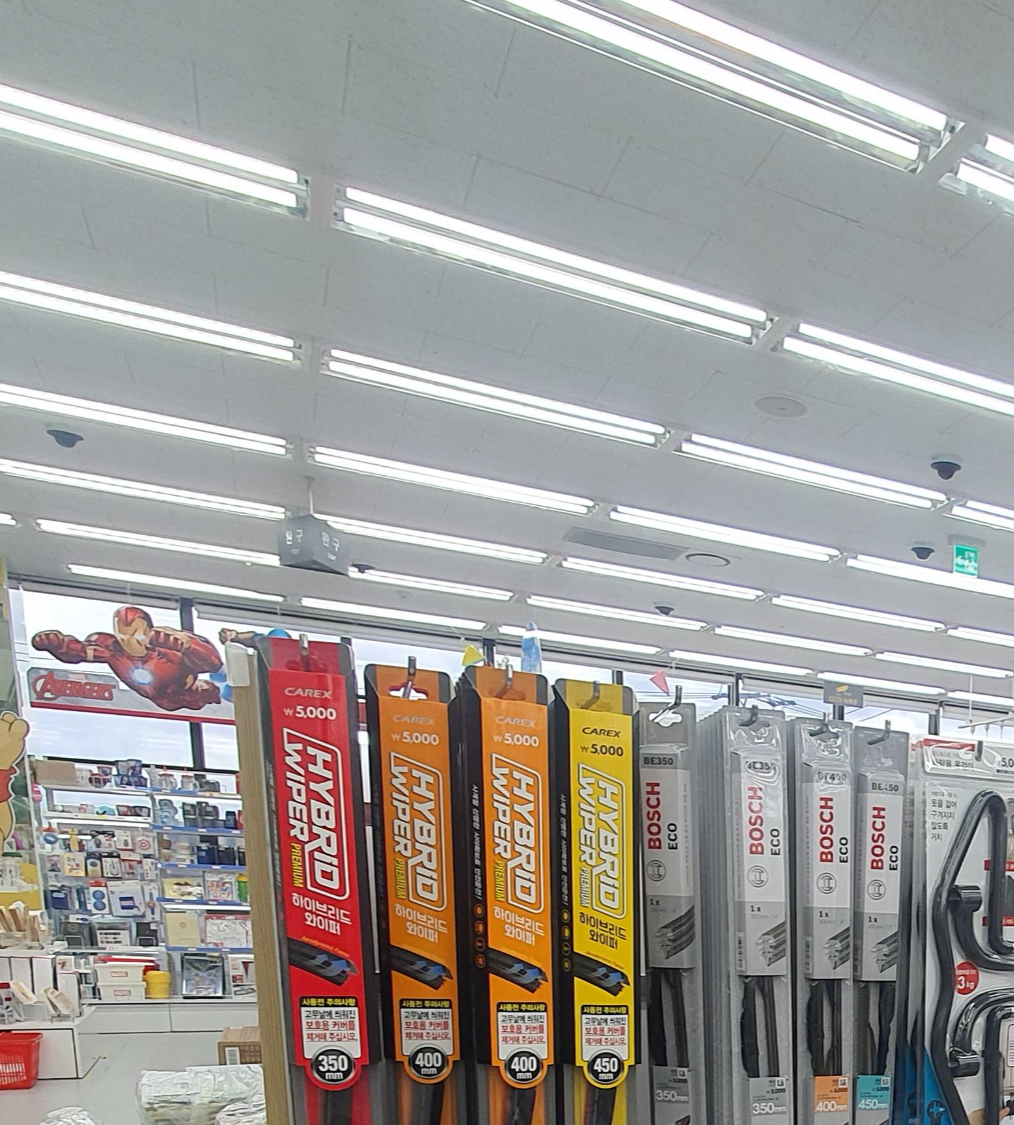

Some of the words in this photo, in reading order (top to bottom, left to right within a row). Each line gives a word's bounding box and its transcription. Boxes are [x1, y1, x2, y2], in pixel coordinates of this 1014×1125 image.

[284, 687, 332, 699] CAREX
[494, 715, 537, 728] CAREX
[582, 726, 621, 738] CAREX
[643, 757, 674, 766] BE350
[284, 743, 309, 842] WIPER
[871, 782, 899, 792] BE450
[306, 746, 341, 890] HYBRID
[391, 765, 413, 858] WIPER
[492, 767, 512, 860] WIPER
[579, 777, 596, 867] WIPER
[646, 782, 662, 849] BOSCH
[747, 786, 765, 855] BOSCH
[411, 768, 438, 901] HYBRID
[512, 770, 537, 909] HYBRID
[667, 822, 678, 850] ECO
[770, 828, 781, 856] ECO
[819, 796, 834, 863] BOSCH
[870, 806, 886, 870] BOSCH
[598, 780, 620, 909] HYBRID
[838, 836, 849, 863] ECO
[889, 845, 899, 871] ECO
[291, 843, 304, 888] PREMIUM
[580, 866, 590, 908] PREMIUM
[292, 893, 352, 924] 하이브리드
[395, 903, 448, 933] 하이브리드
[493, 906, 545, 936] 하이브리드
[304, 912, 341, 935] 와이퍼
[405, 921, 438, 943] 와이퍼
[504, 923, 536, 945] 와이퍼
[579, 912, 627, 940] 하이브리드
[589, 929, 618, 950] 와이퍼
[319, 1055, 349, 1071] 350
[415, 1053, 442, 1067] 400
[511, 1056, 537, 1072] 400
[593, 1058, 619, 1073] 450
[752, 1102, 786, 1114] 350mm
[816, 1101, 848, 1112] 400mm
[859, 1099, 888, 1110] 450mm
